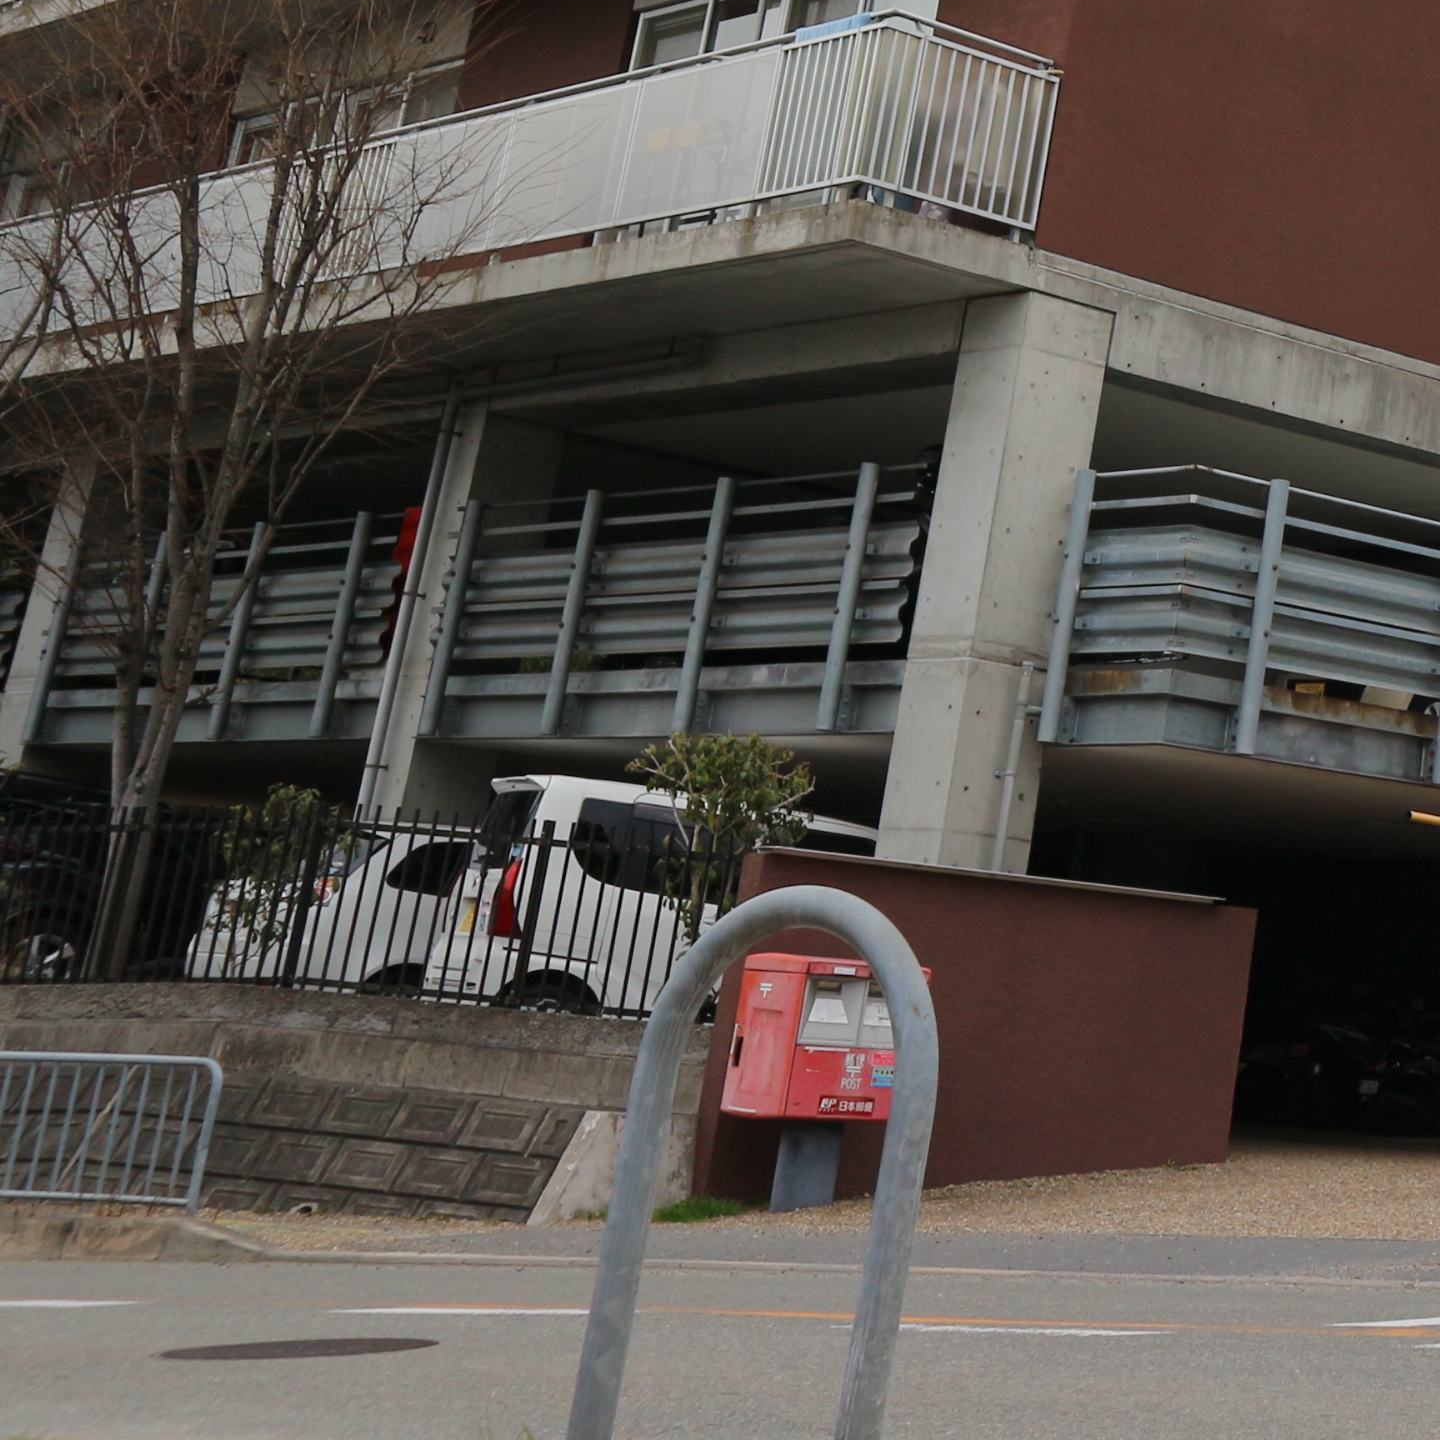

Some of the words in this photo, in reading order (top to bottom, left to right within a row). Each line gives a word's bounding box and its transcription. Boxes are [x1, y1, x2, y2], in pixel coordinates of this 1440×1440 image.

[845, 1053, 866, 1068] 郵便
[840, 1077, 862, 1090] POST
[838, 1100, 874, 1113] 日本郵便
